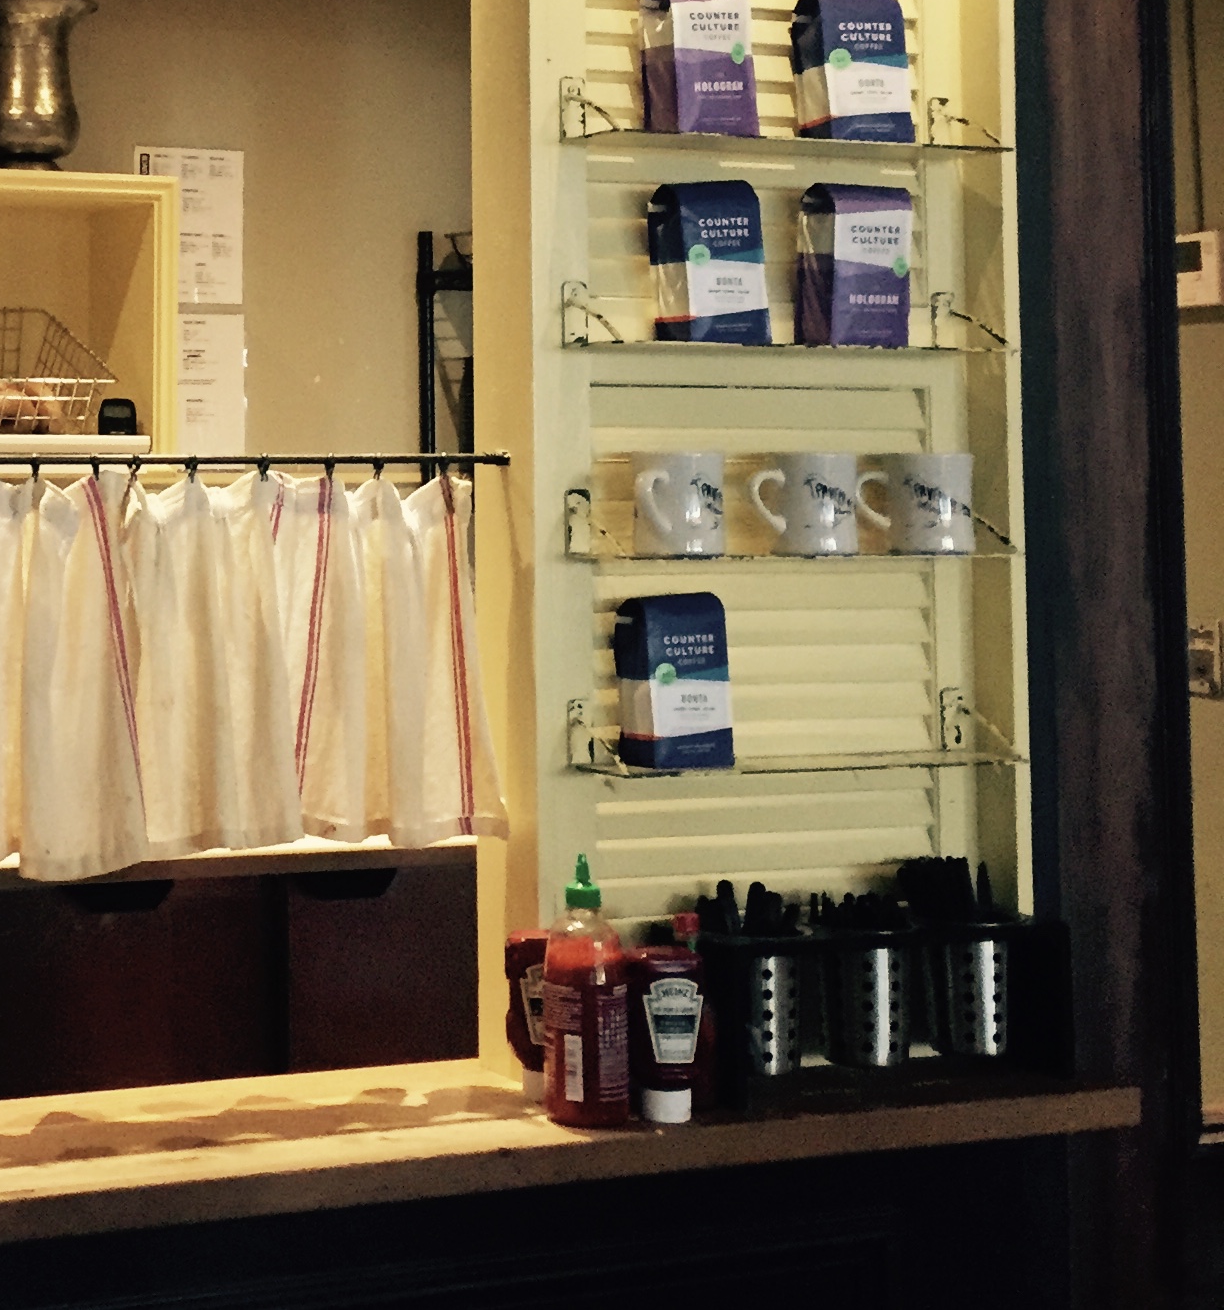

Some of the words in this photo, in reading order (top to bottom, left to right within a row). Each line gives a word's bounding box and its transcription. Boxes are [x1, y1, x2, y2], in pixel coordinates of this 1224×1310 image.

[690, 12, 740, 20] COUNTER
[692, 23, 740, 31] CULTURE
[839, 22, 892, 31] COUNTER
[840, 33, 892, 41] CULTURE
[698, 217, 749, 227] COUNTER
[701, 228, 750, 238] CULTURE
[851, 225, 900, 233] COUNTER
[852, 237, 899, 245] CULTURE
[664, 634, 714, 644] COUNTER
[666, 646, 715, 656] CULTURE
